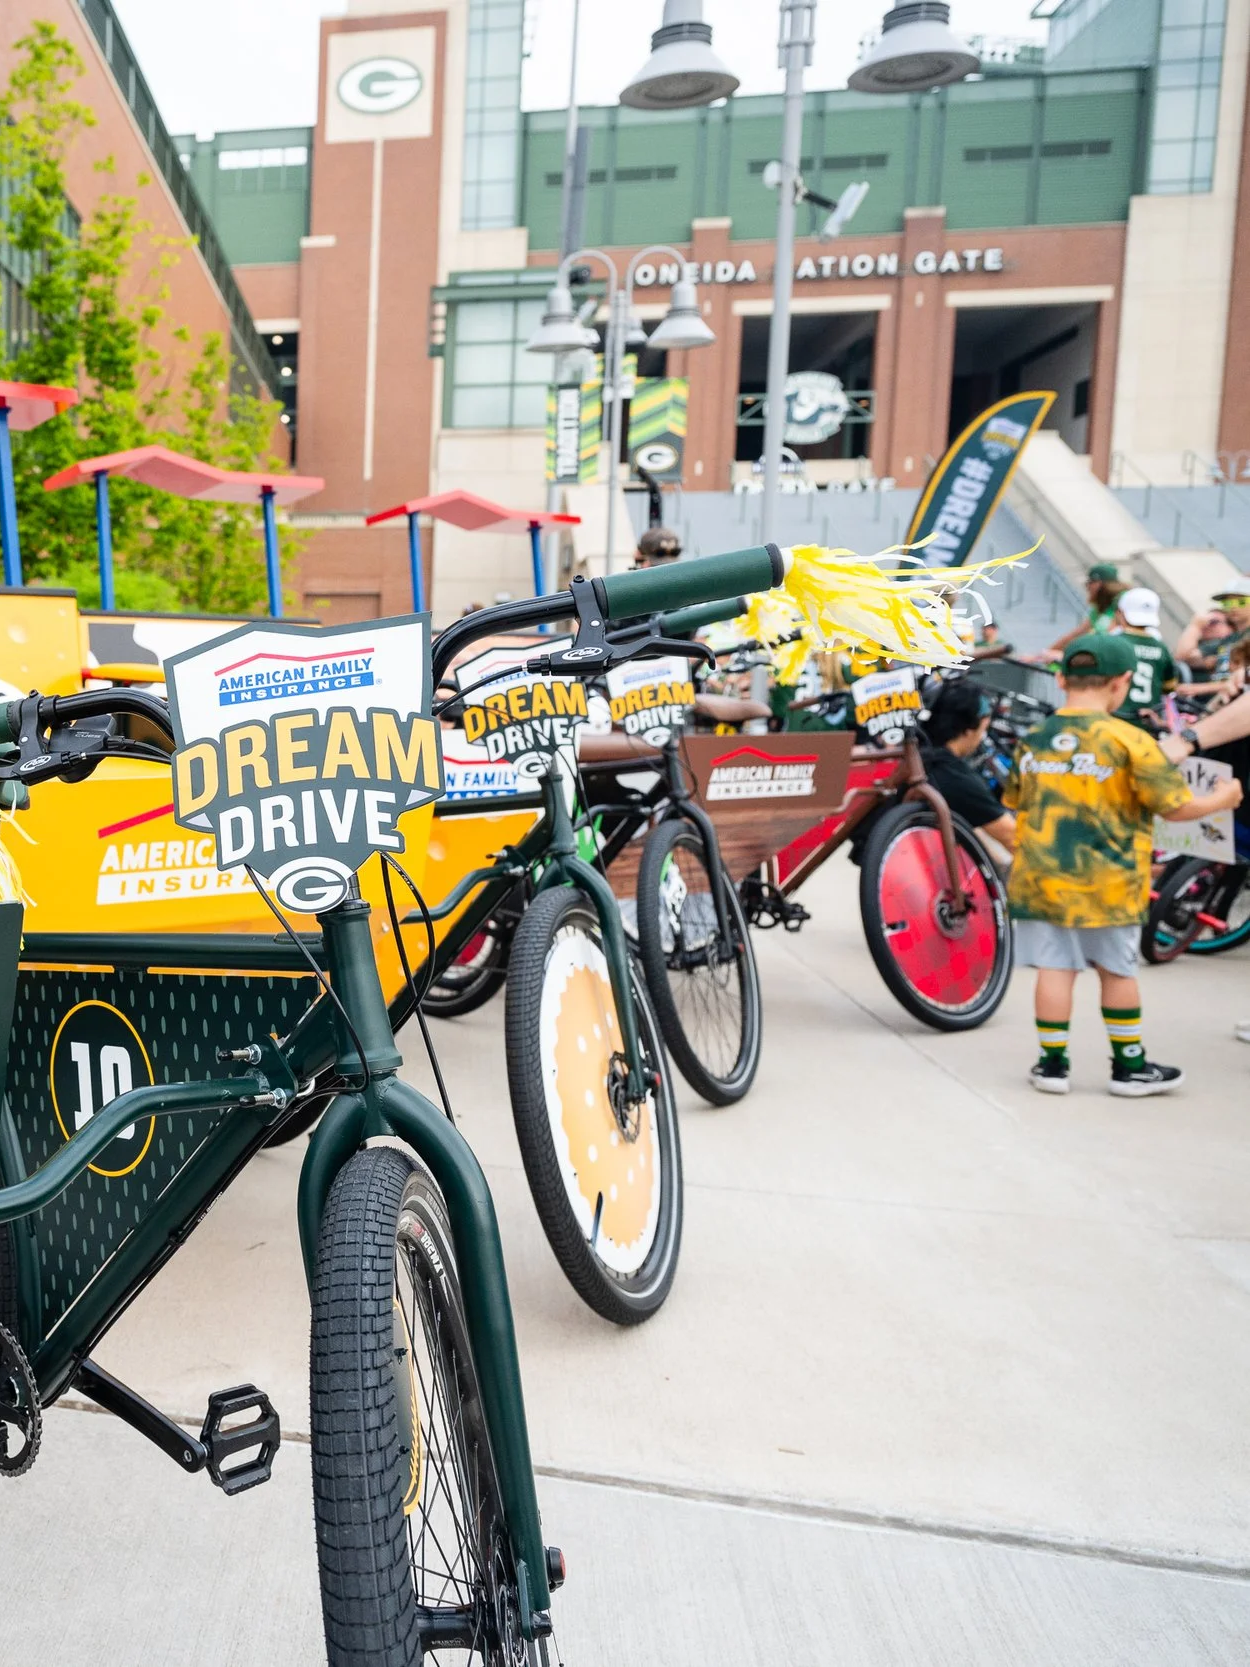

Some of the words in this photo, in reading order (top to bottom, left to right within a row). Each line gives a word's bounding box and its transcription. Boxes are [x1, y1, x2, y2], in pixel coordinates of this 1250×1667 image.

[635, 260, 756, 286] ONEIDA
[796, 254, 898, 279] ATION
[913, 248, 1004, 274] GATE
[218, 667, 305, 692] AMERICAN
[311, 657, 373, 678] FAMILY
[230, 676, 363, 703] INSURANCE
[462, 681, 588, 744] DREAM
[610, 681, 696, 722] DREAM
[854, 690, 922, 726] DREAM
[624, 705, 686, 735] DRIVE
[485, 718, 574, 763] DRIVE
[176, 710, 441, 819] DREAM
[463, 771, 518, 787] FAMILY
[709, 765, 774, 782] AMERICAN
[773, 763, 816, 780] FAMILY
[717, 783, 803, 795] INSURANCE
[218, 788, 400, 866] DRIVE
[99, 838, 217, 873] AMERIC
[70, 1041, 135, 1140] 10
